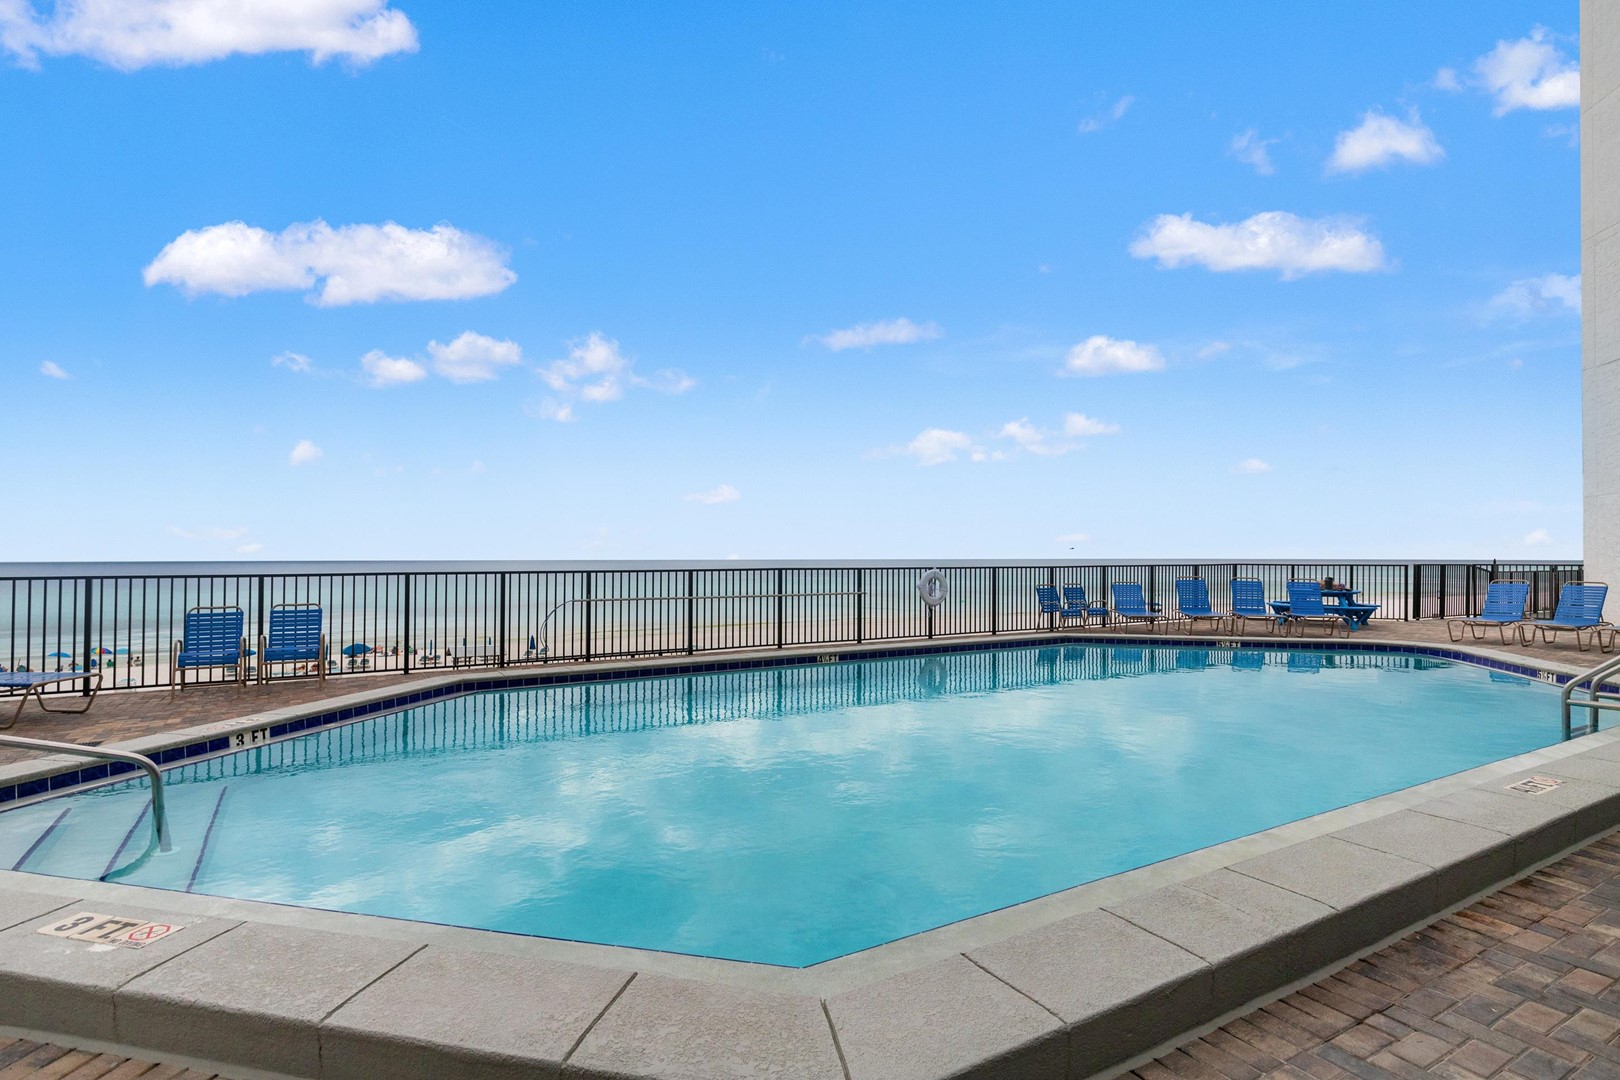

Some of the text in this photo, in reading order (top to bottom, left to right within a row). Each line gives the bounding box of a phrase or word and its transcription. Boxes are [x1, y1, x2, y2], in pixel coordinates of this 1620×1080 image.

[1547, 672, 1555, 683] FT
[236, 728, 268, 746] 3 FT
[54, 916, 95, 932] 3
